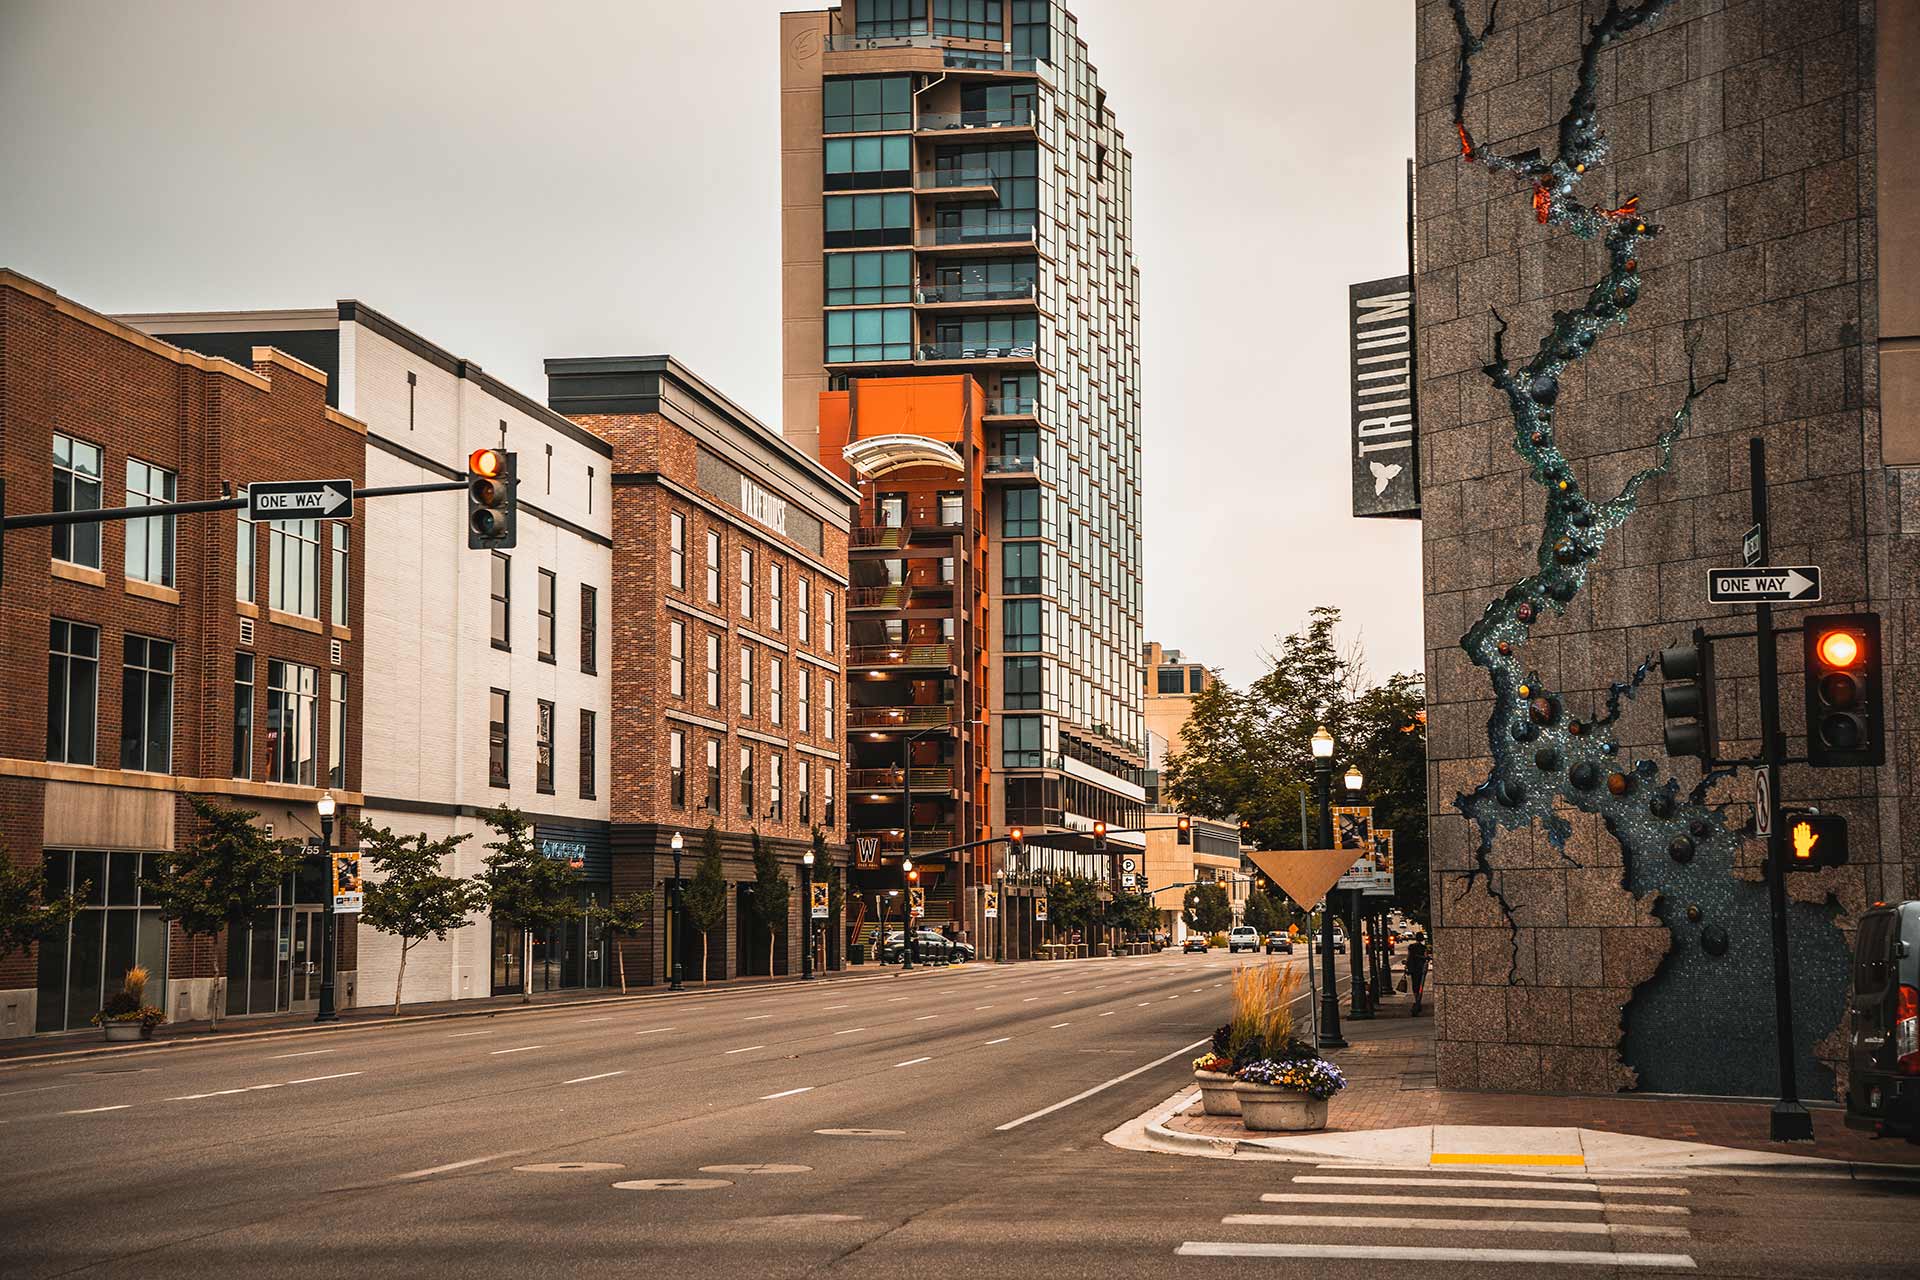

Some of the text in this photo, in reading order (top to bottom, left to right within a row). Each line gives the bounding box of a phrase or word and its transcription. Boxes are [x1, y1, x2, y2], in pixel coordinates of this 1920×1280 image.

[1356, 291, 1412, 457] TRILLIUM
[260, 494, 323, 508] ONE WAY
[740, 474, 787, 537] WAREHOUSE
[1720, 578, 1786, 592] ONE WAY
[300, 845, 320, 855] 755
[857, 837, 878, 863] W
